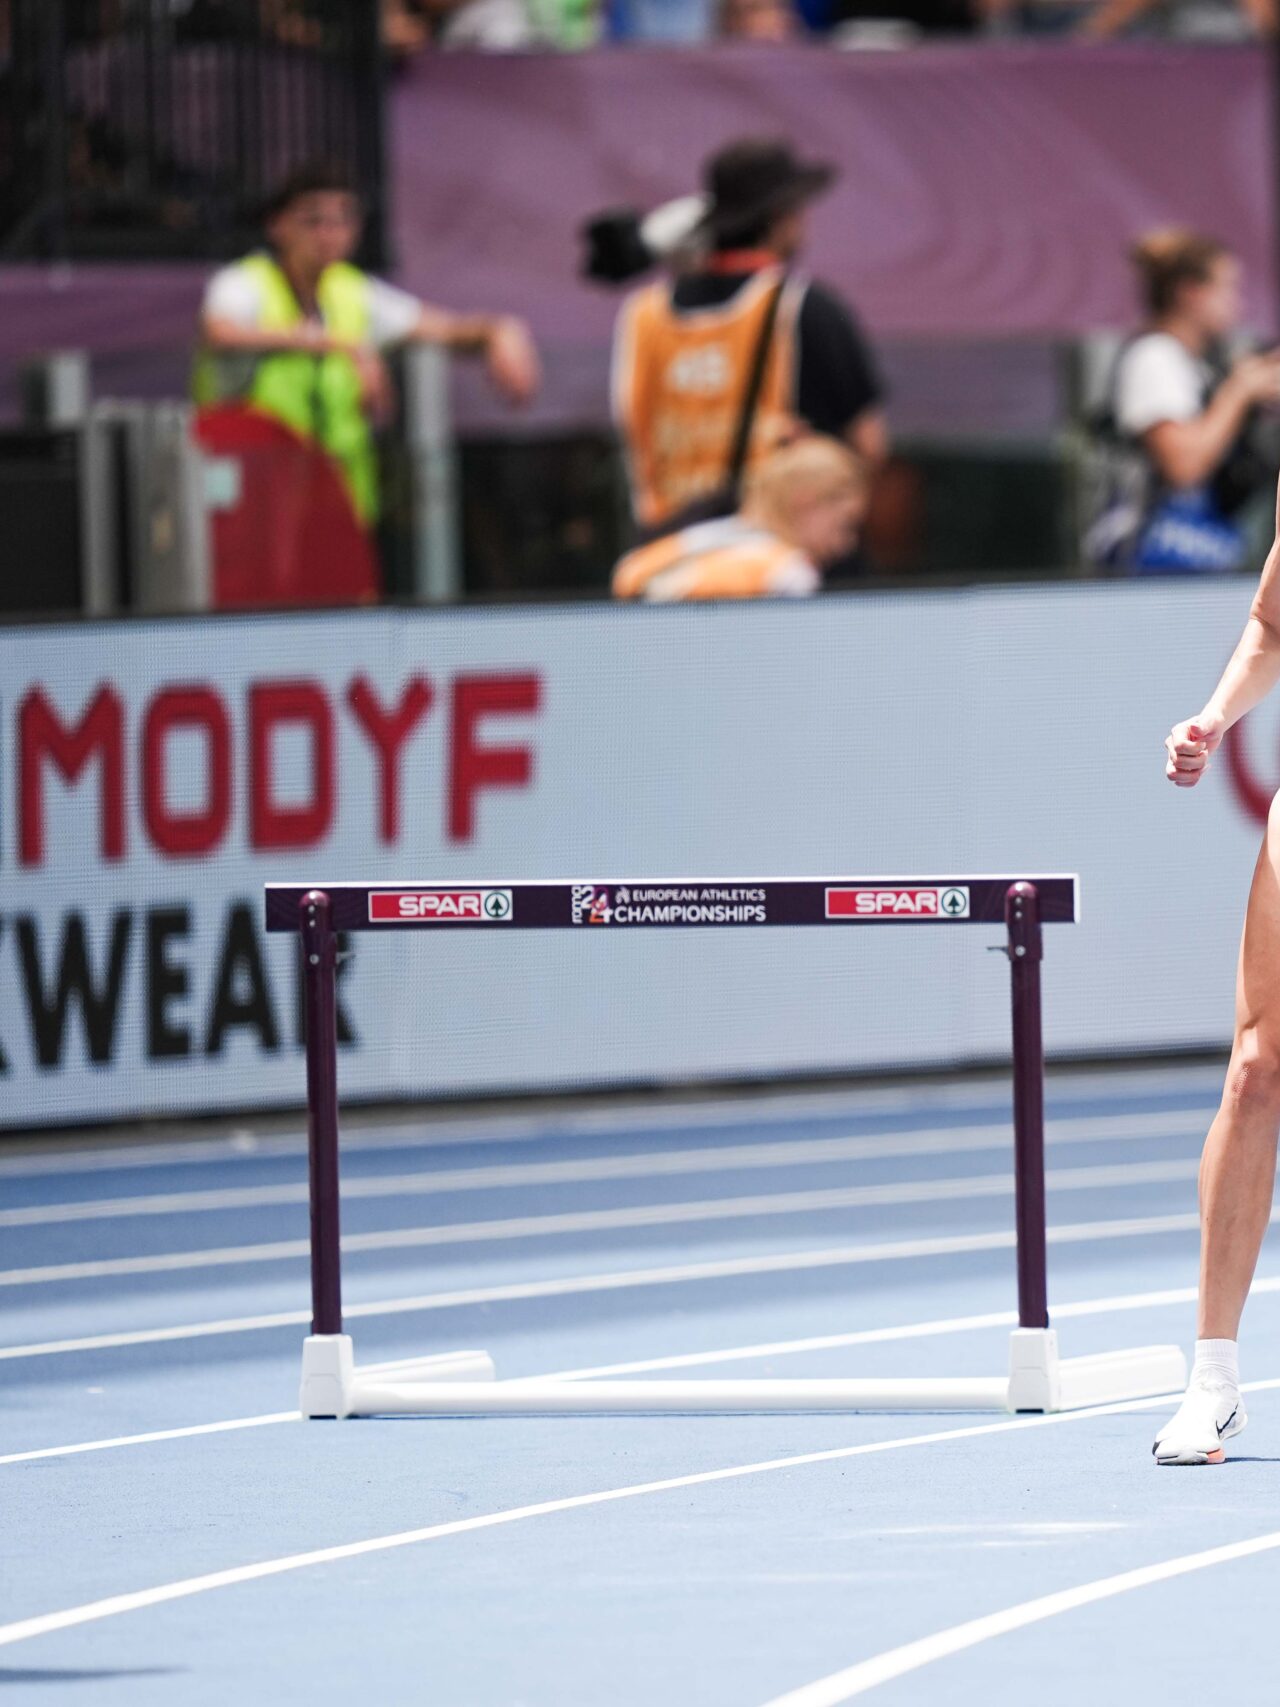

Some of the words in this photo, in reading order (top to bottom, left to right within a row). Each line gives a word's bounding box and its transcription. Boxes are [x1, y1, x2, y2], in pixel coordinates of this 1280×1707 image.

[17, 666, 546, 868] MODYF
[399, 895, 480, 916] SPAR
[632, 889, 699, 902] EUROPEAN
[700, 889, 766, 901] ATHLETICS
[855, 892, 937, 913] SPAR
[614, 904, 767, 923] CHAMPIONSHIPS
